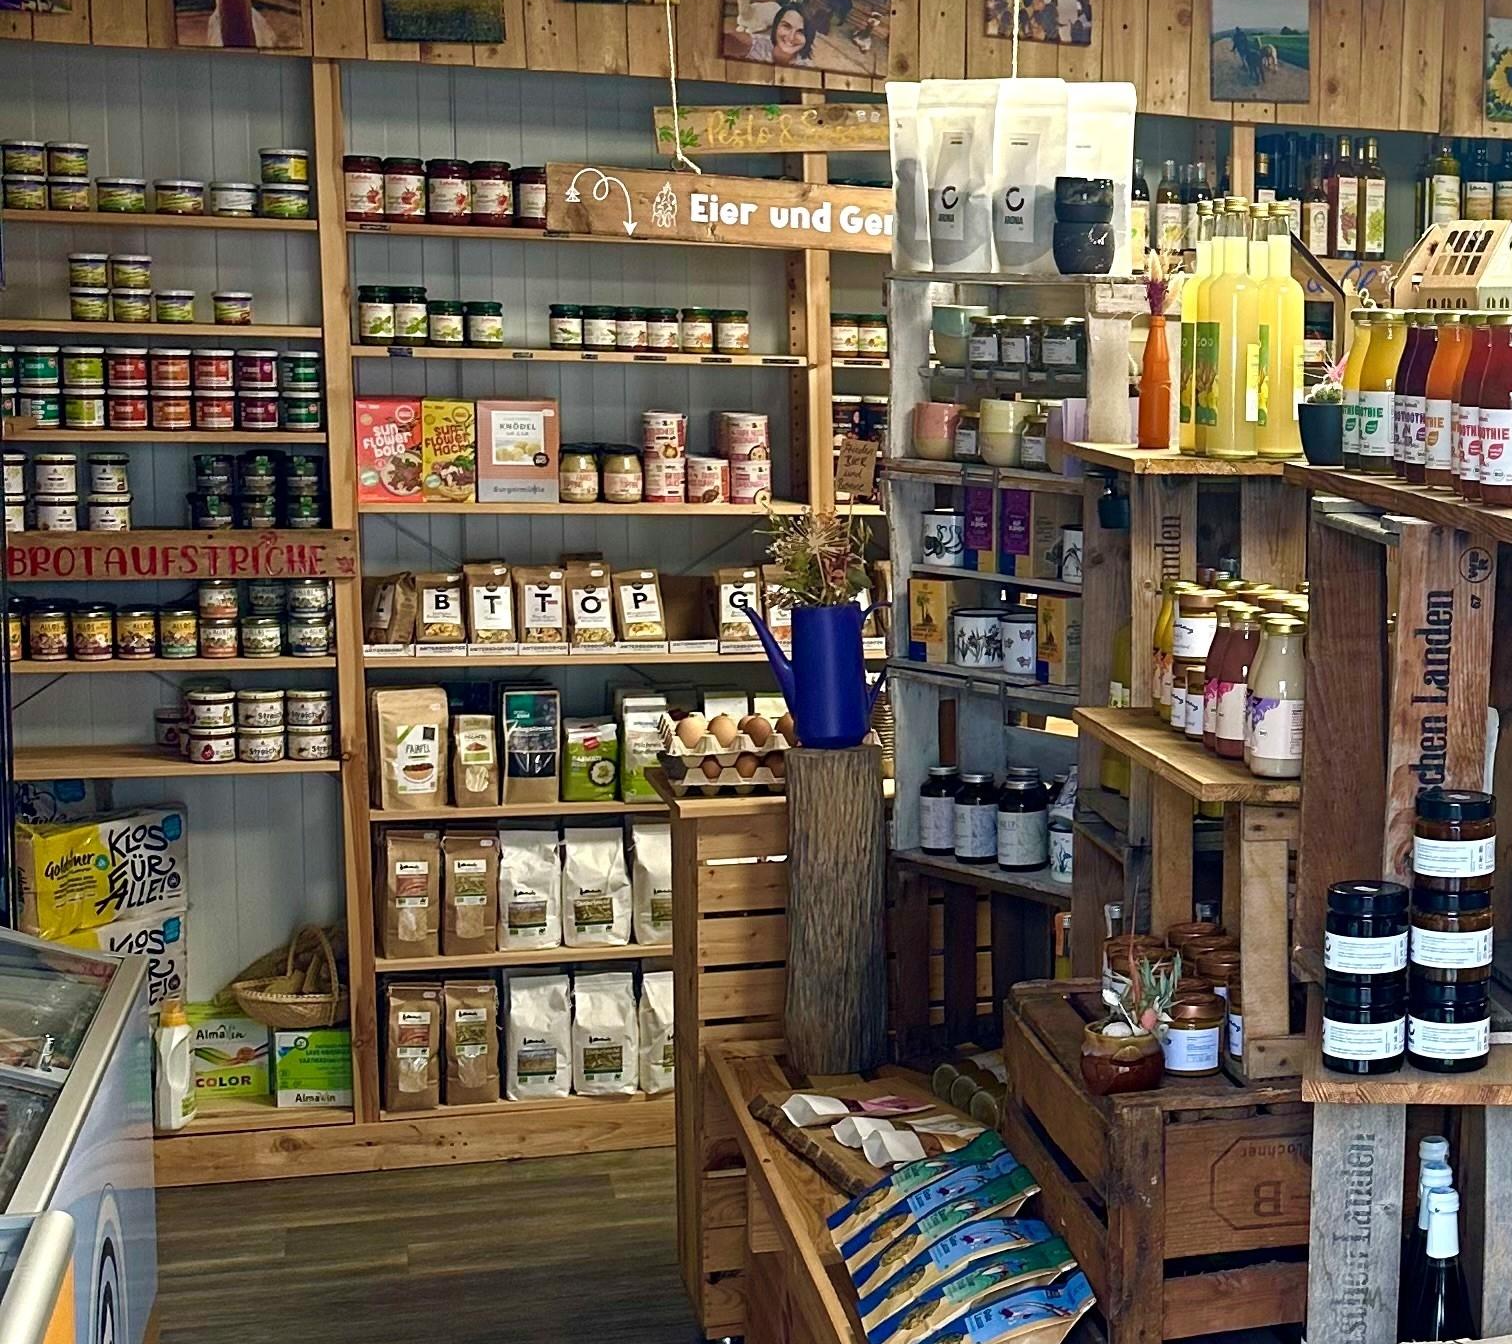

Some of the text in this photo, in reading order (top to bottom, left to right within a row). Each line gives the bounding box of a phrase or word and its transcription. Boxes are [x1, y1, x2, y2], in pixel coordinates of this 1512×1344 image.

[690, 192, 758, 226] Eier
[769, 200, 833, 233] und
[7, 542, 327, 578] BROTAUFSTRICHE
[1155, 515, 1182, 583] anden
[1411, 589, 1454, 705] Landen
[1408, 715, 1448, 795] schen
[108, 824, 168, 867] KLOS
[108, 854, 175, 892] FÜR
[94, 875, 167, 915] ALLE!
[195, 1075, 252, 1088] COLOR
